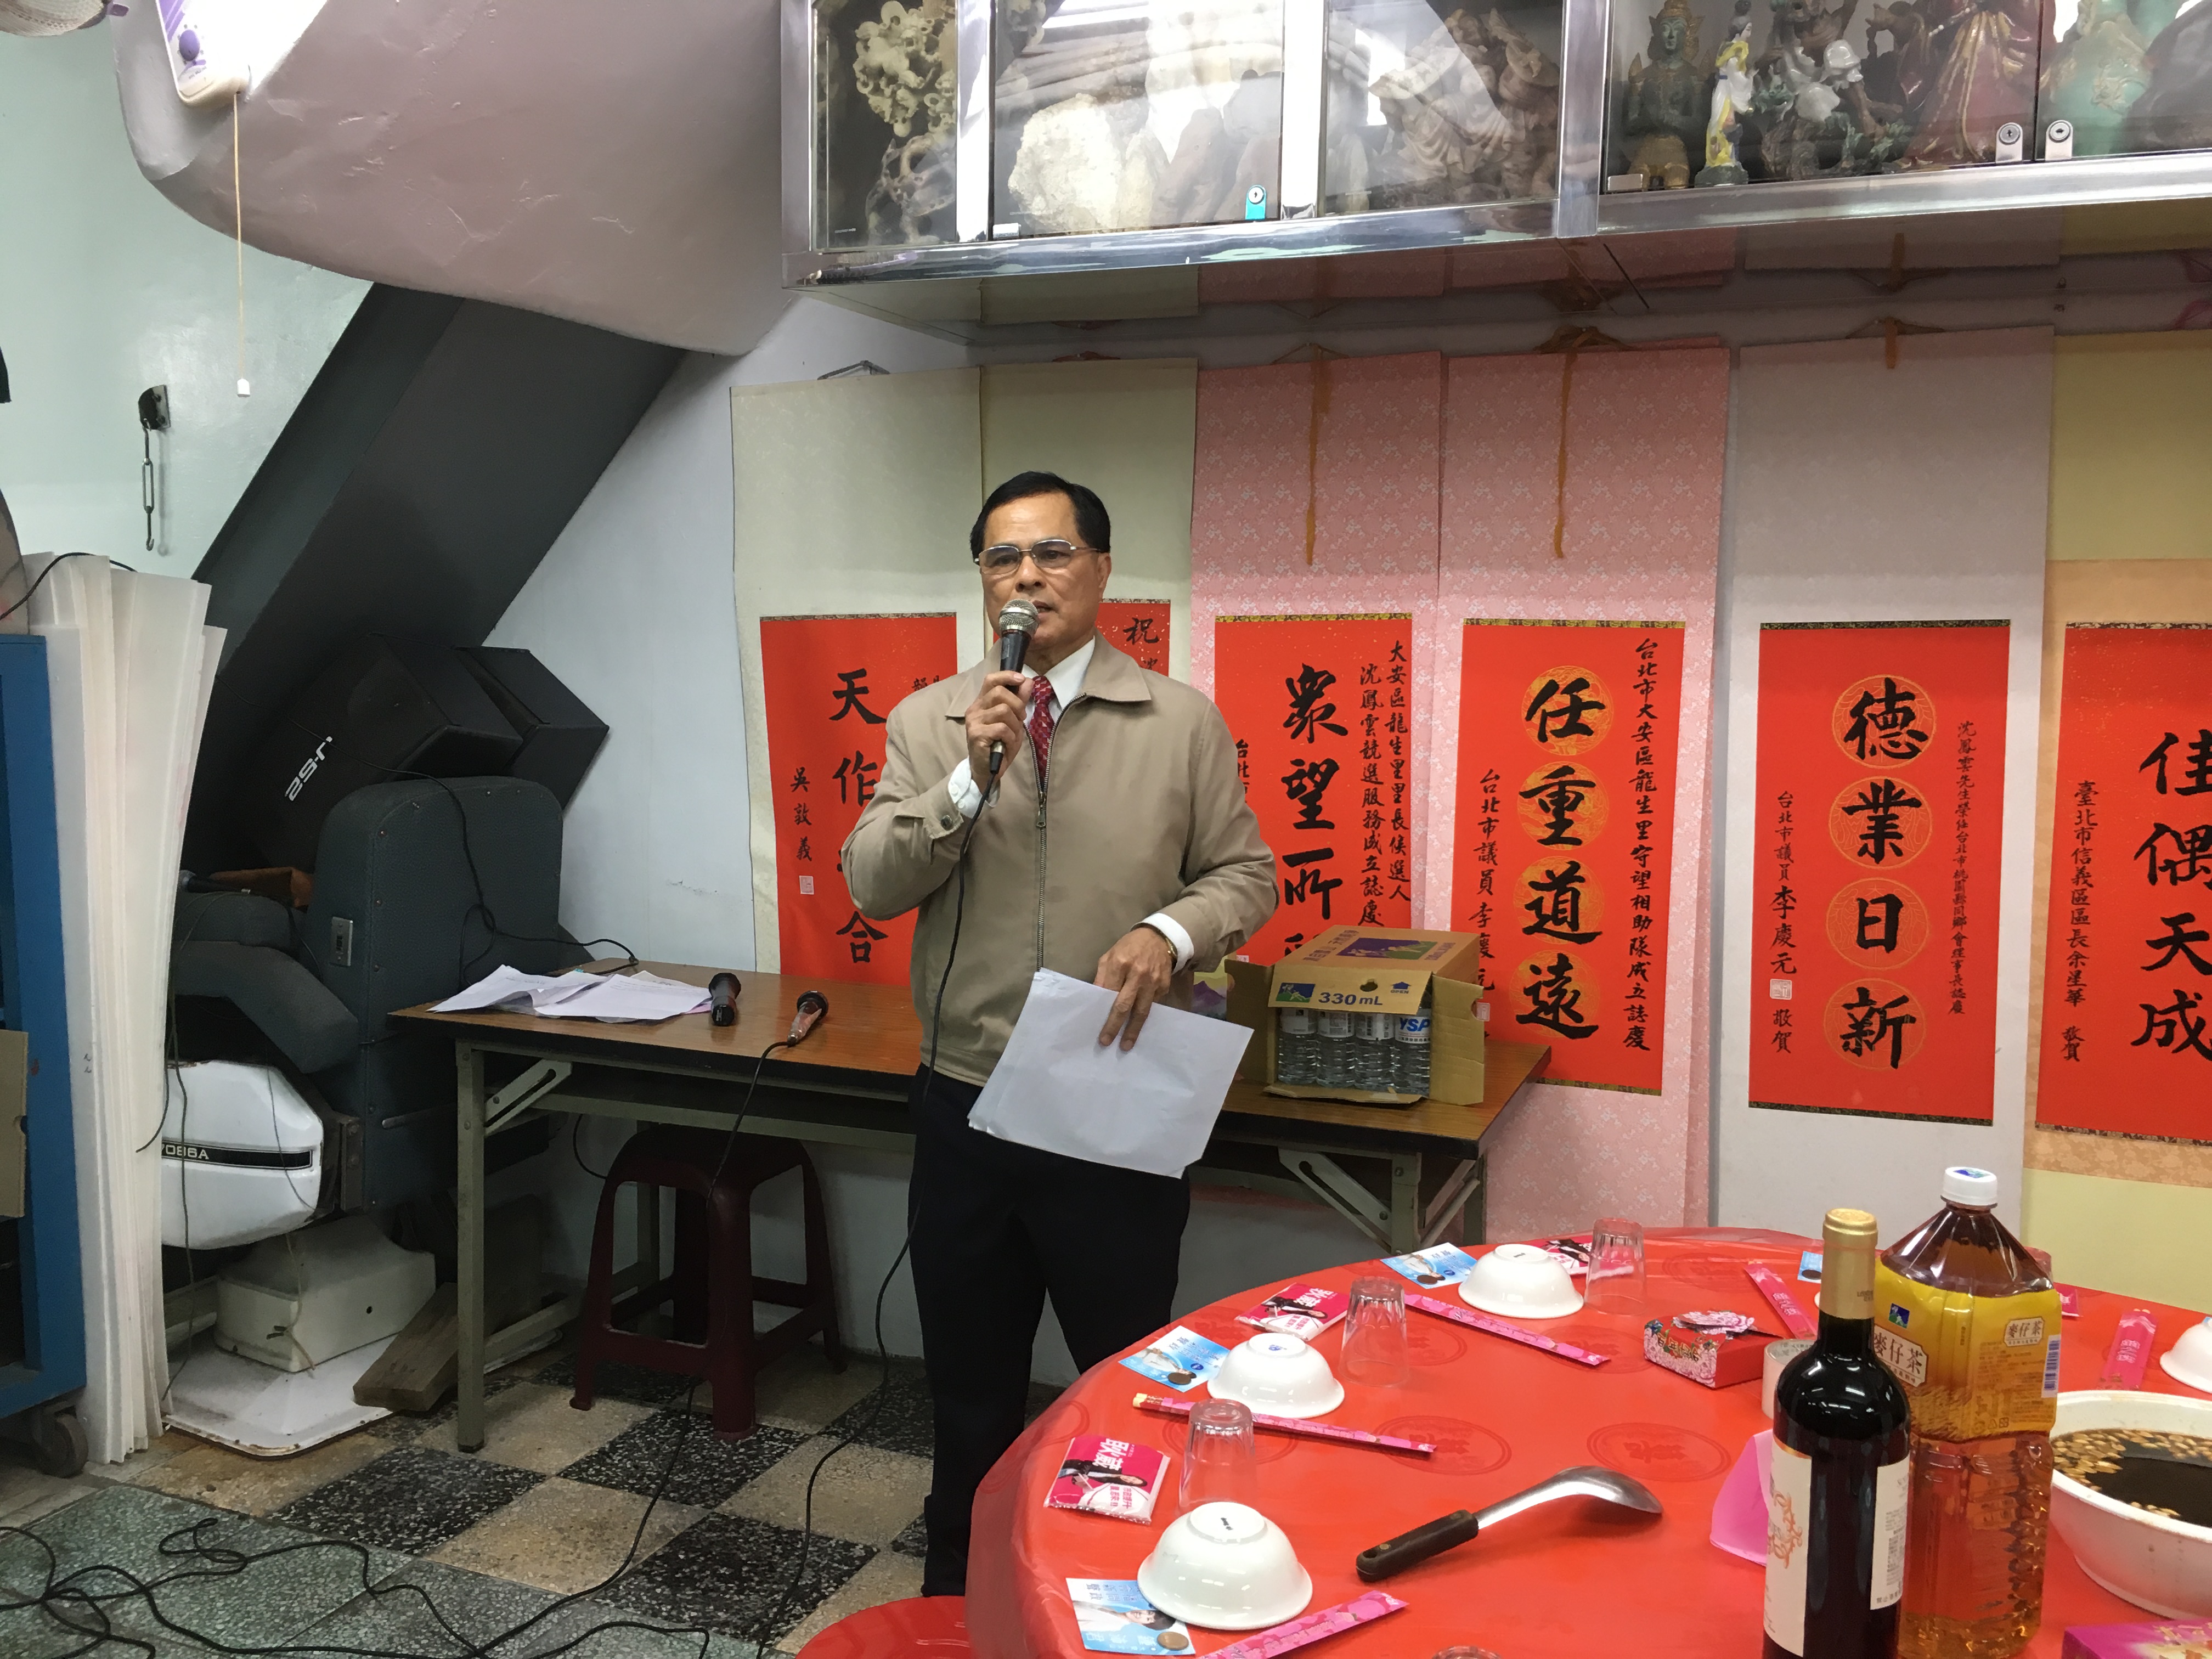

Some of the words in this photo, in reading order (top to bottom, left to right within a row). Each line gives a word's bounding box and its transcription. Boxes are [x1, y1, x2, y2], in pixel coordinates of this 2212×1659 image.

[1122, 617, 1160, 645] 祝
[1318, 992, 1356, 1005] 330
[1359, 996, 1383, 1006] mL
[1515, 677, 1605, 1040] 任重道遠
[1839, 677, 1928, 1069] 德業日新
[2130, 729, 2212, 1062] 佳偶天成
